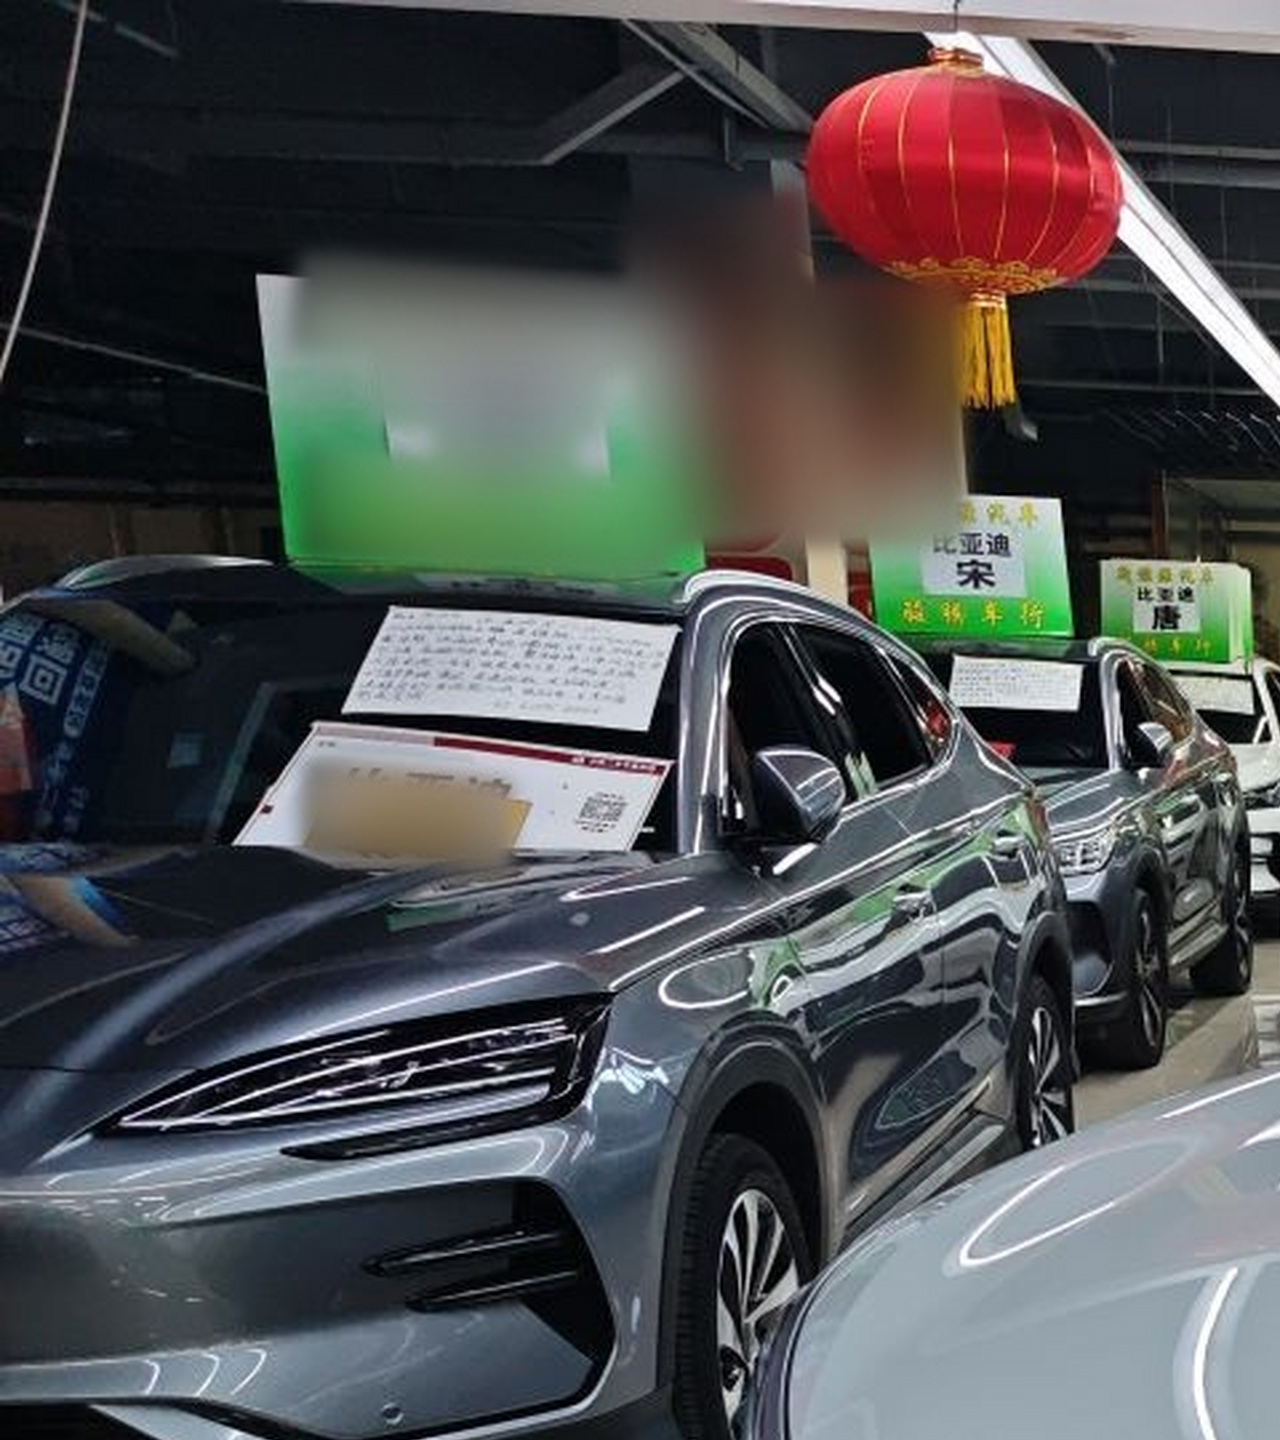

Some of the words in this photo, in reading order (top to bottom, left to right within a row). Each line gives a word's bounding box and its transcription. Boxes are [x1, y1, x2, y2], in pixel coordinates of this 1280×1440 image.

[932, 533, 1012, 557] 比亚迪
[956, 559, 996, 590] 宋
[1136, 586, 1195, 603] 比亚迪
[1151, 605, 1181, 630] 唐
